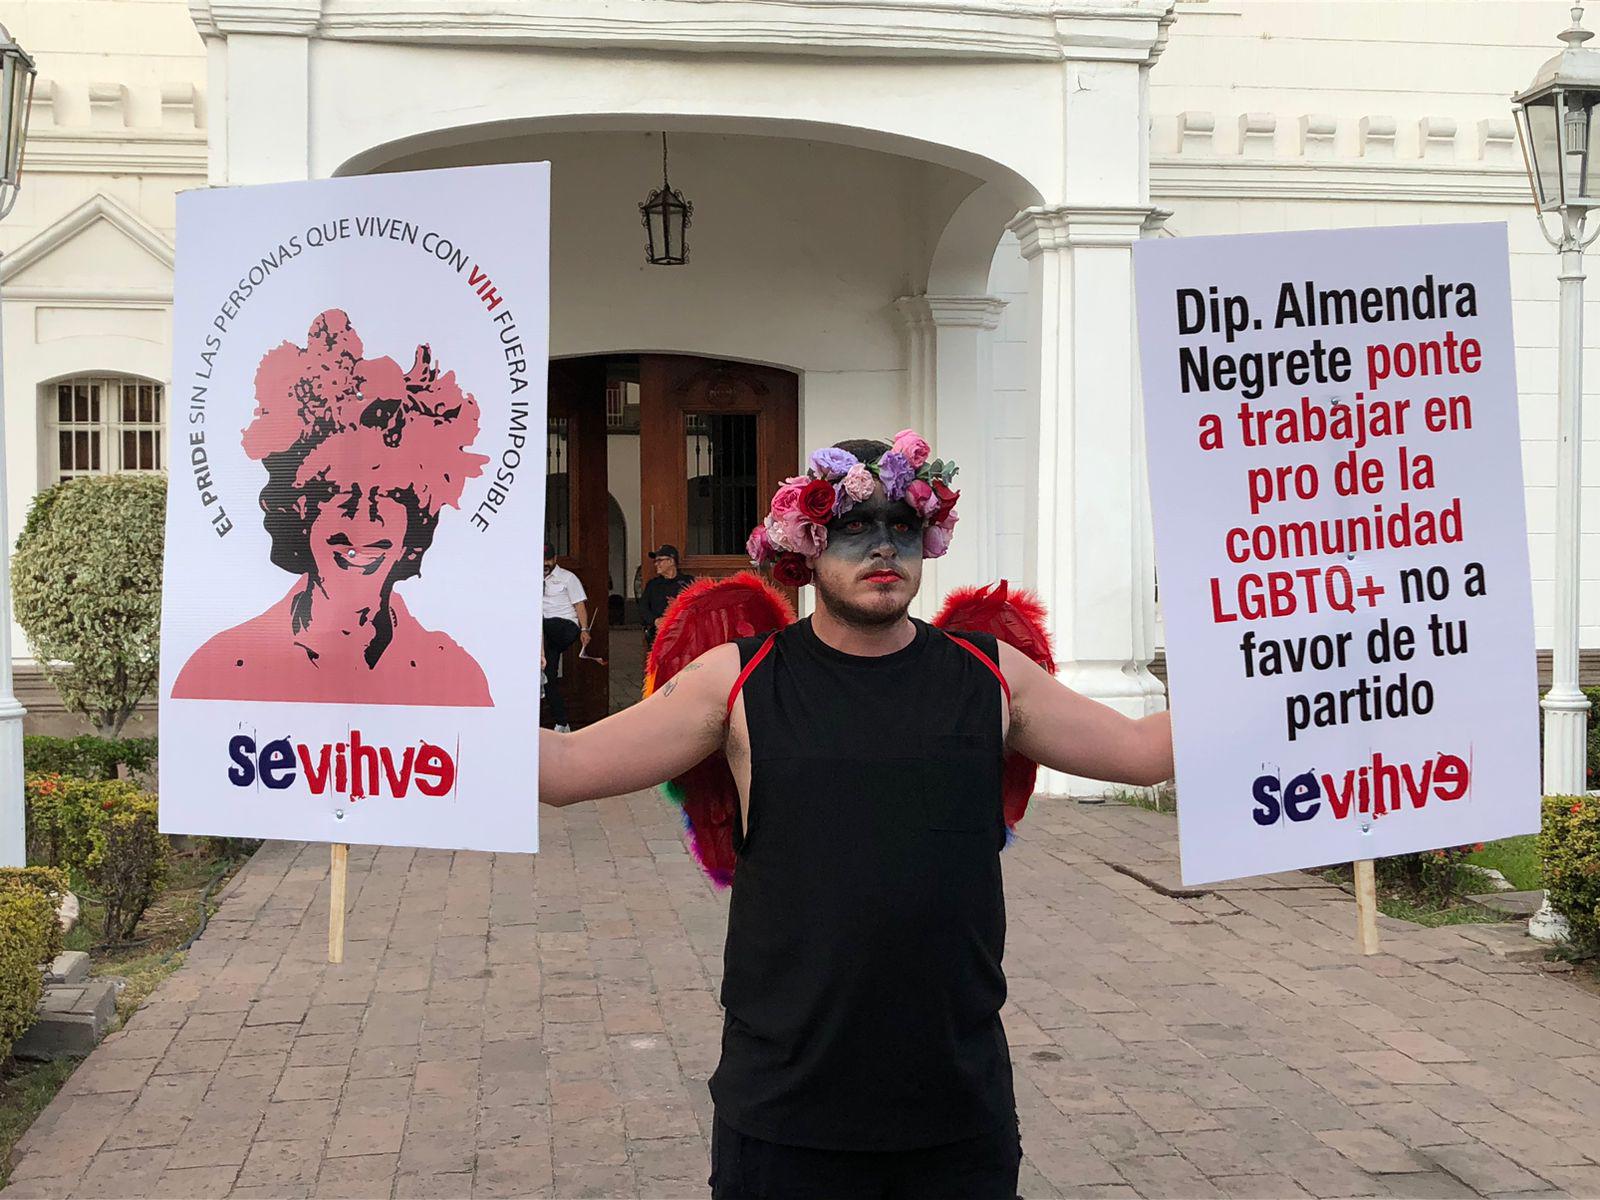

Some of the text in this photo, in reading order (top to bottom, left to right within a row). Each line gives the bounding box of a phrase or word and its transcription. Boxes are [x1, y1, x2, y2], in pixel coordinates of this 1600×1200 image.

[1176, 275, 1478, 343] Dip. Almendra
[190, 217, 528, 538] EL PRIDE SIN LAS PERSONAS QUE VIVEN CON VIH FUERA IMPOSIBLE
[1179, 331, 1481, 399] Negrete ponte
[1199, 392, 1472, 450] a trabajar en
[1248, 446, 1435, 514] pro de la
[1226, 498, 1463, 563] comunidad
[1210, 562, 1487, 623] LGBTQ+ no a
[1240, 614, 1468, 678] favor de tu
[1286, 673, 1434, 741] partido
